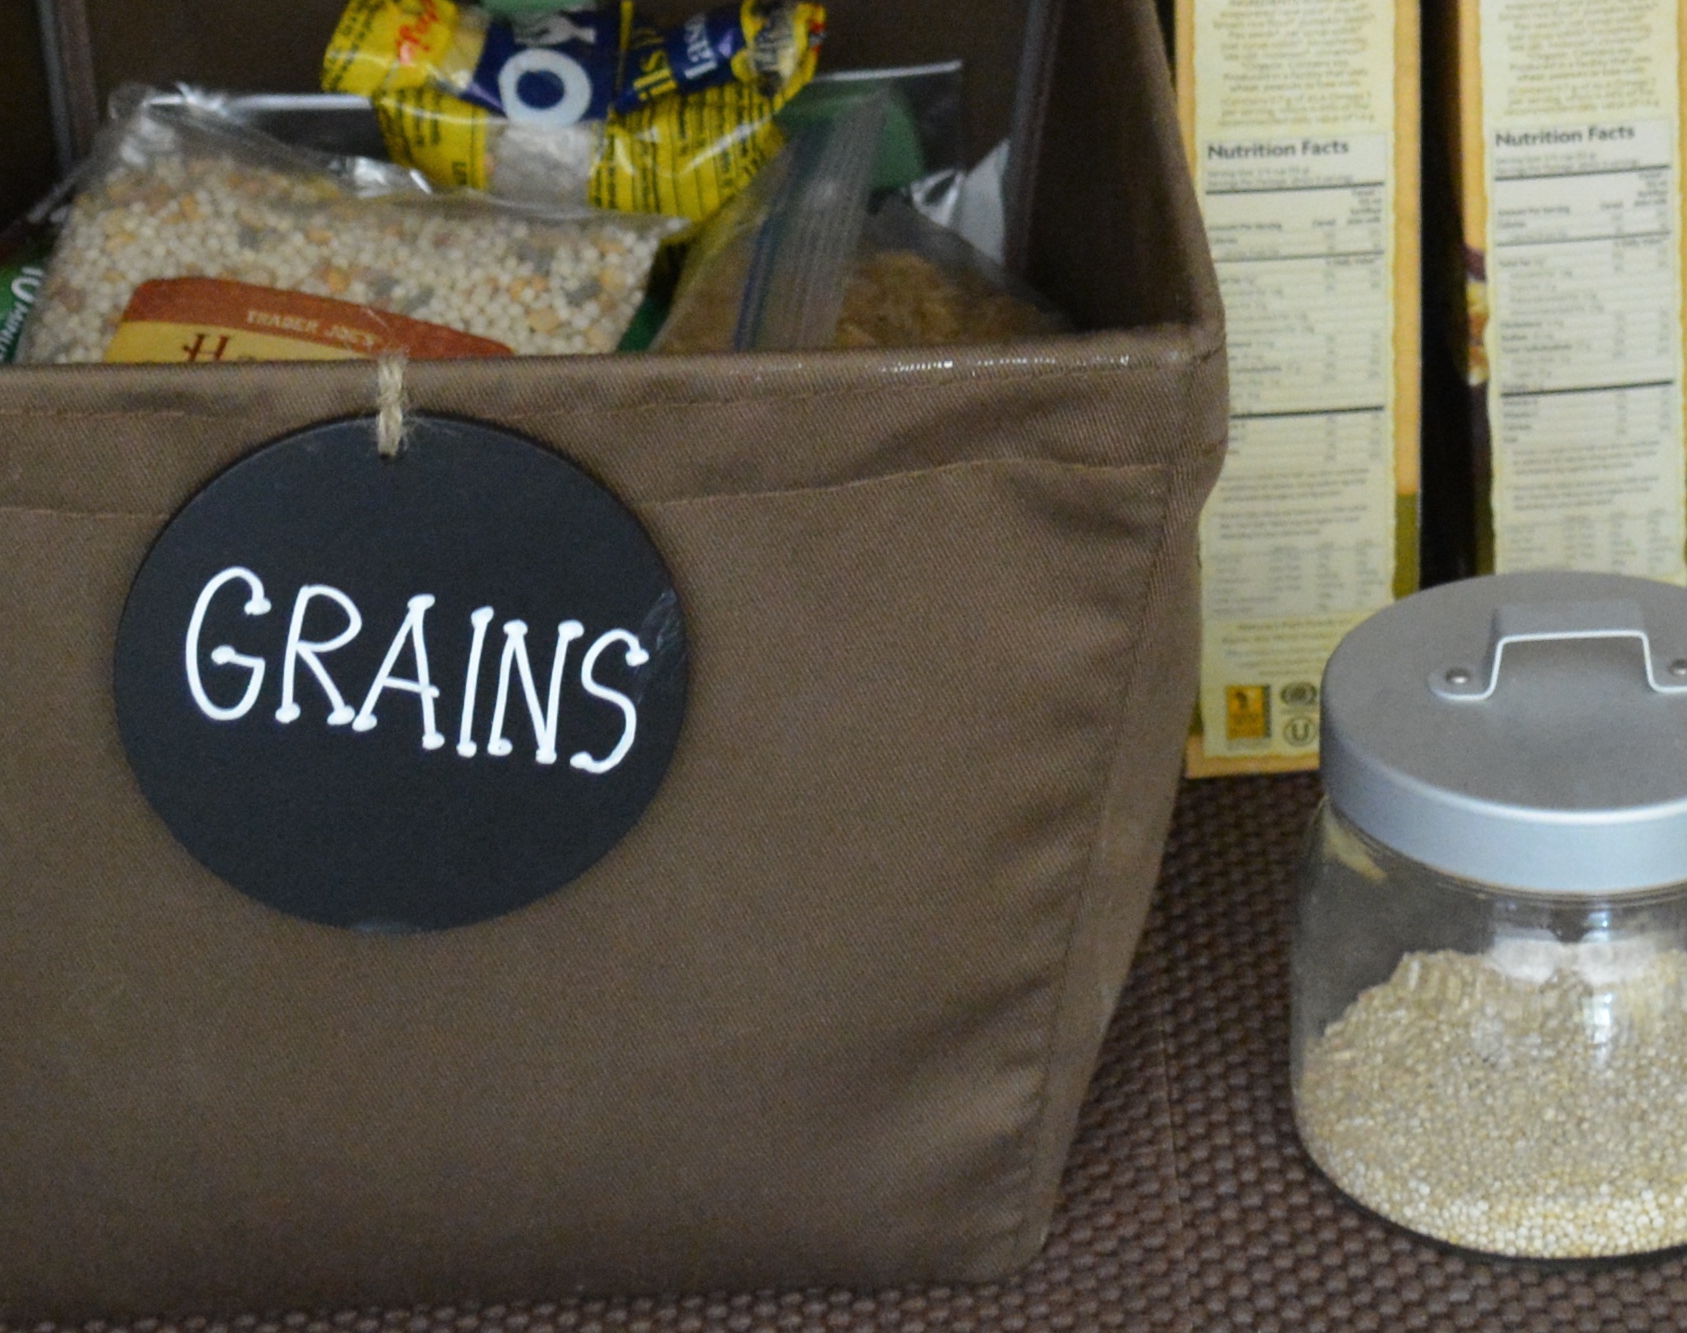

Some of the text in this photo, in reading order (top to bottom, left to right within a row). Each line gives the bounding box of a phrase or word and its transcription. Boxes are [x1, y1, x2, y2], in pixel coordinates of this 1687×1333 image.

[1206, 137, 1350, 162] Nutrition Facts
[1495, 122, 1636, 150] Nutrition Facts
[185, 565, 650, 775] GRAINS
